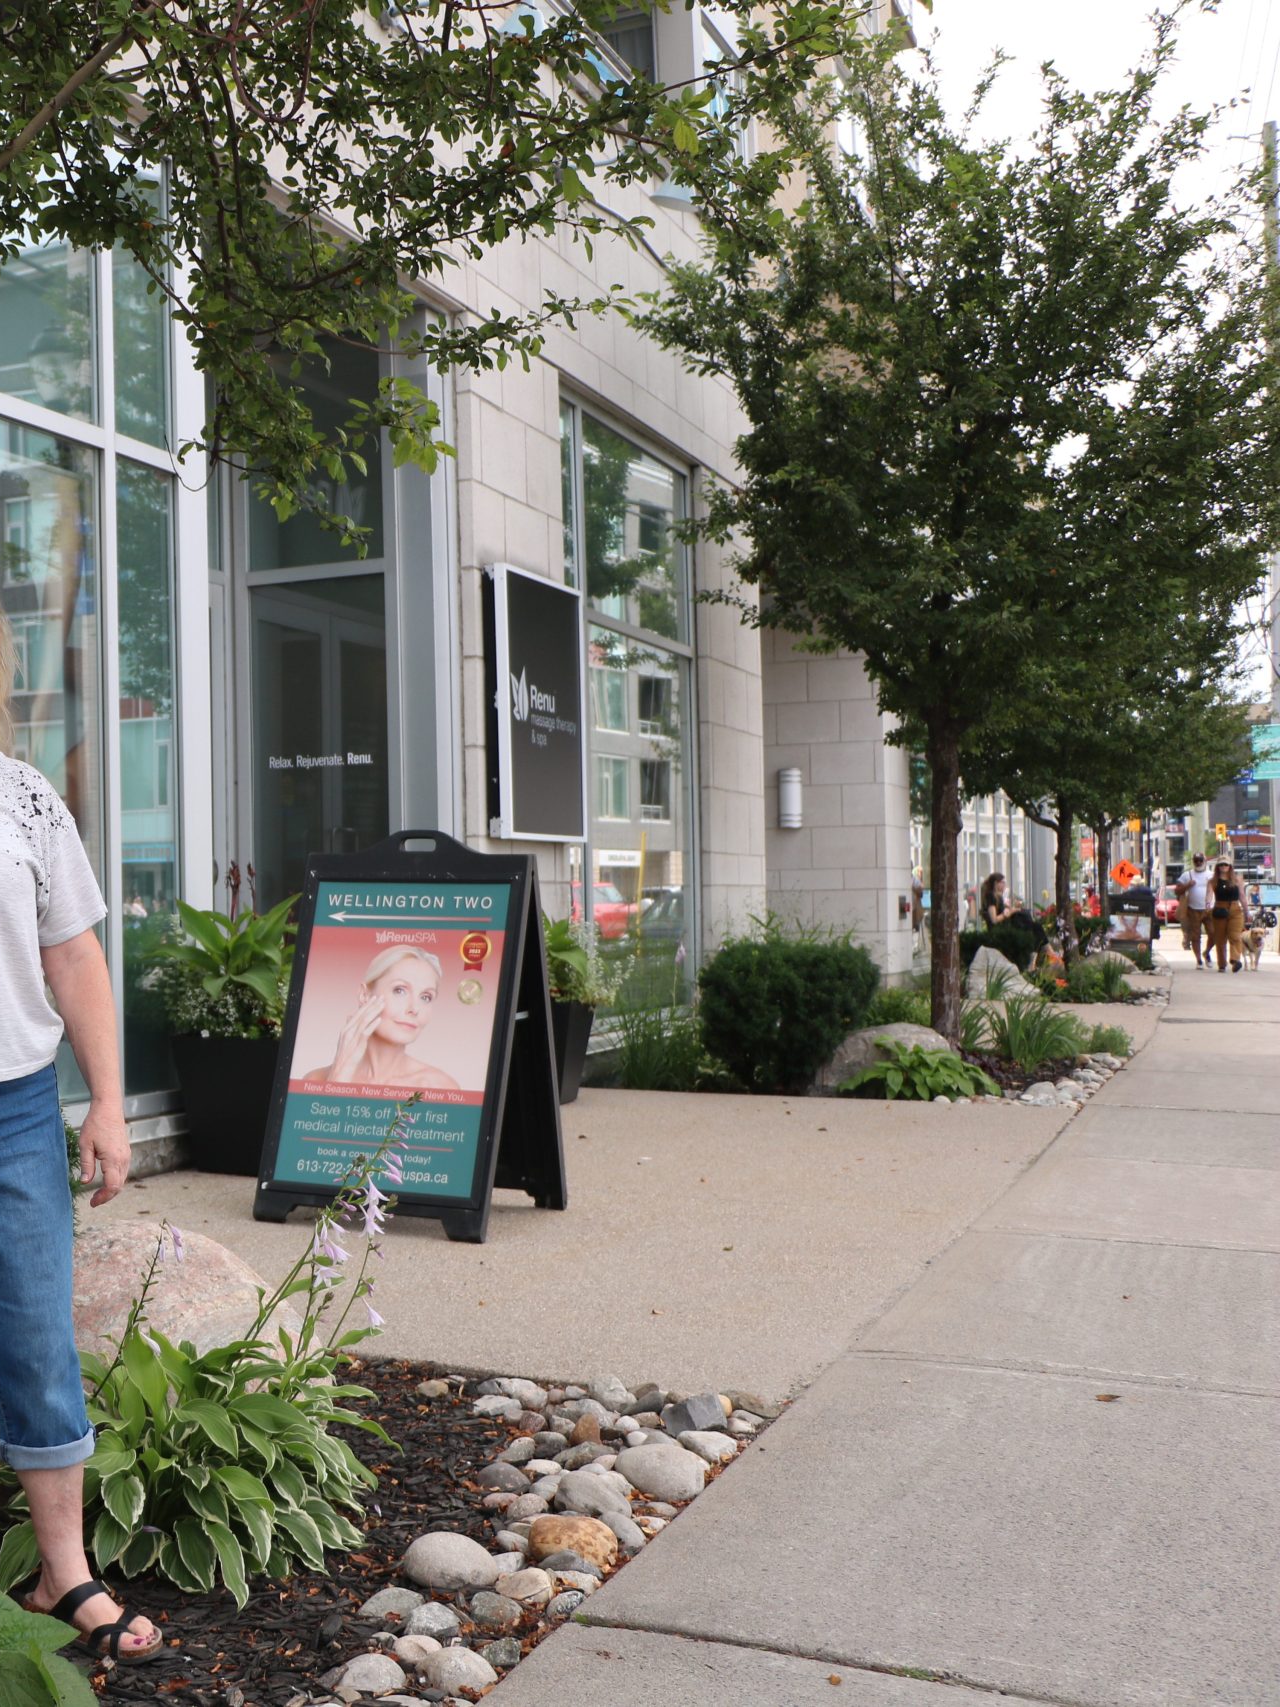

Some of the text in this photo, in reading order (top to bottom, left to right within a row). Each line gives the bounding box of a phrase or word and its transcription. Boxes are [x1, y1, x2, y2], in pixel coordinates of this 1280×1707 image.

[530, 684, 555, 713] Renu
[531, 713, 576, 736] massage therapy
[537, 733, 548, 748] spa
[269, 751, 373, 770] Relax. Rejuvenate. Renu.
[328, 894, 492, 909] WELLINGTON TWO
[304, 1082, 322, 1092] New
[324, 1084, 360, 1096] Season.
[362, 1085, 381, 1096] New
[424, 1091, 445, 1102] New
[446, 1092, 467, 1102] You.
[310, 1102, 341, 1116] Save
[345, 1104, 371, 1118] 15%
[375, 1107, 392, 1120] off
[425, 1110, 449, 1124] first
[294, 1117, 341, 1134] medical
[406, 1125, 466, 1143] treatment
[317, 1147, 338, 1157] book
[403, 1153, 432, 1166] today!
